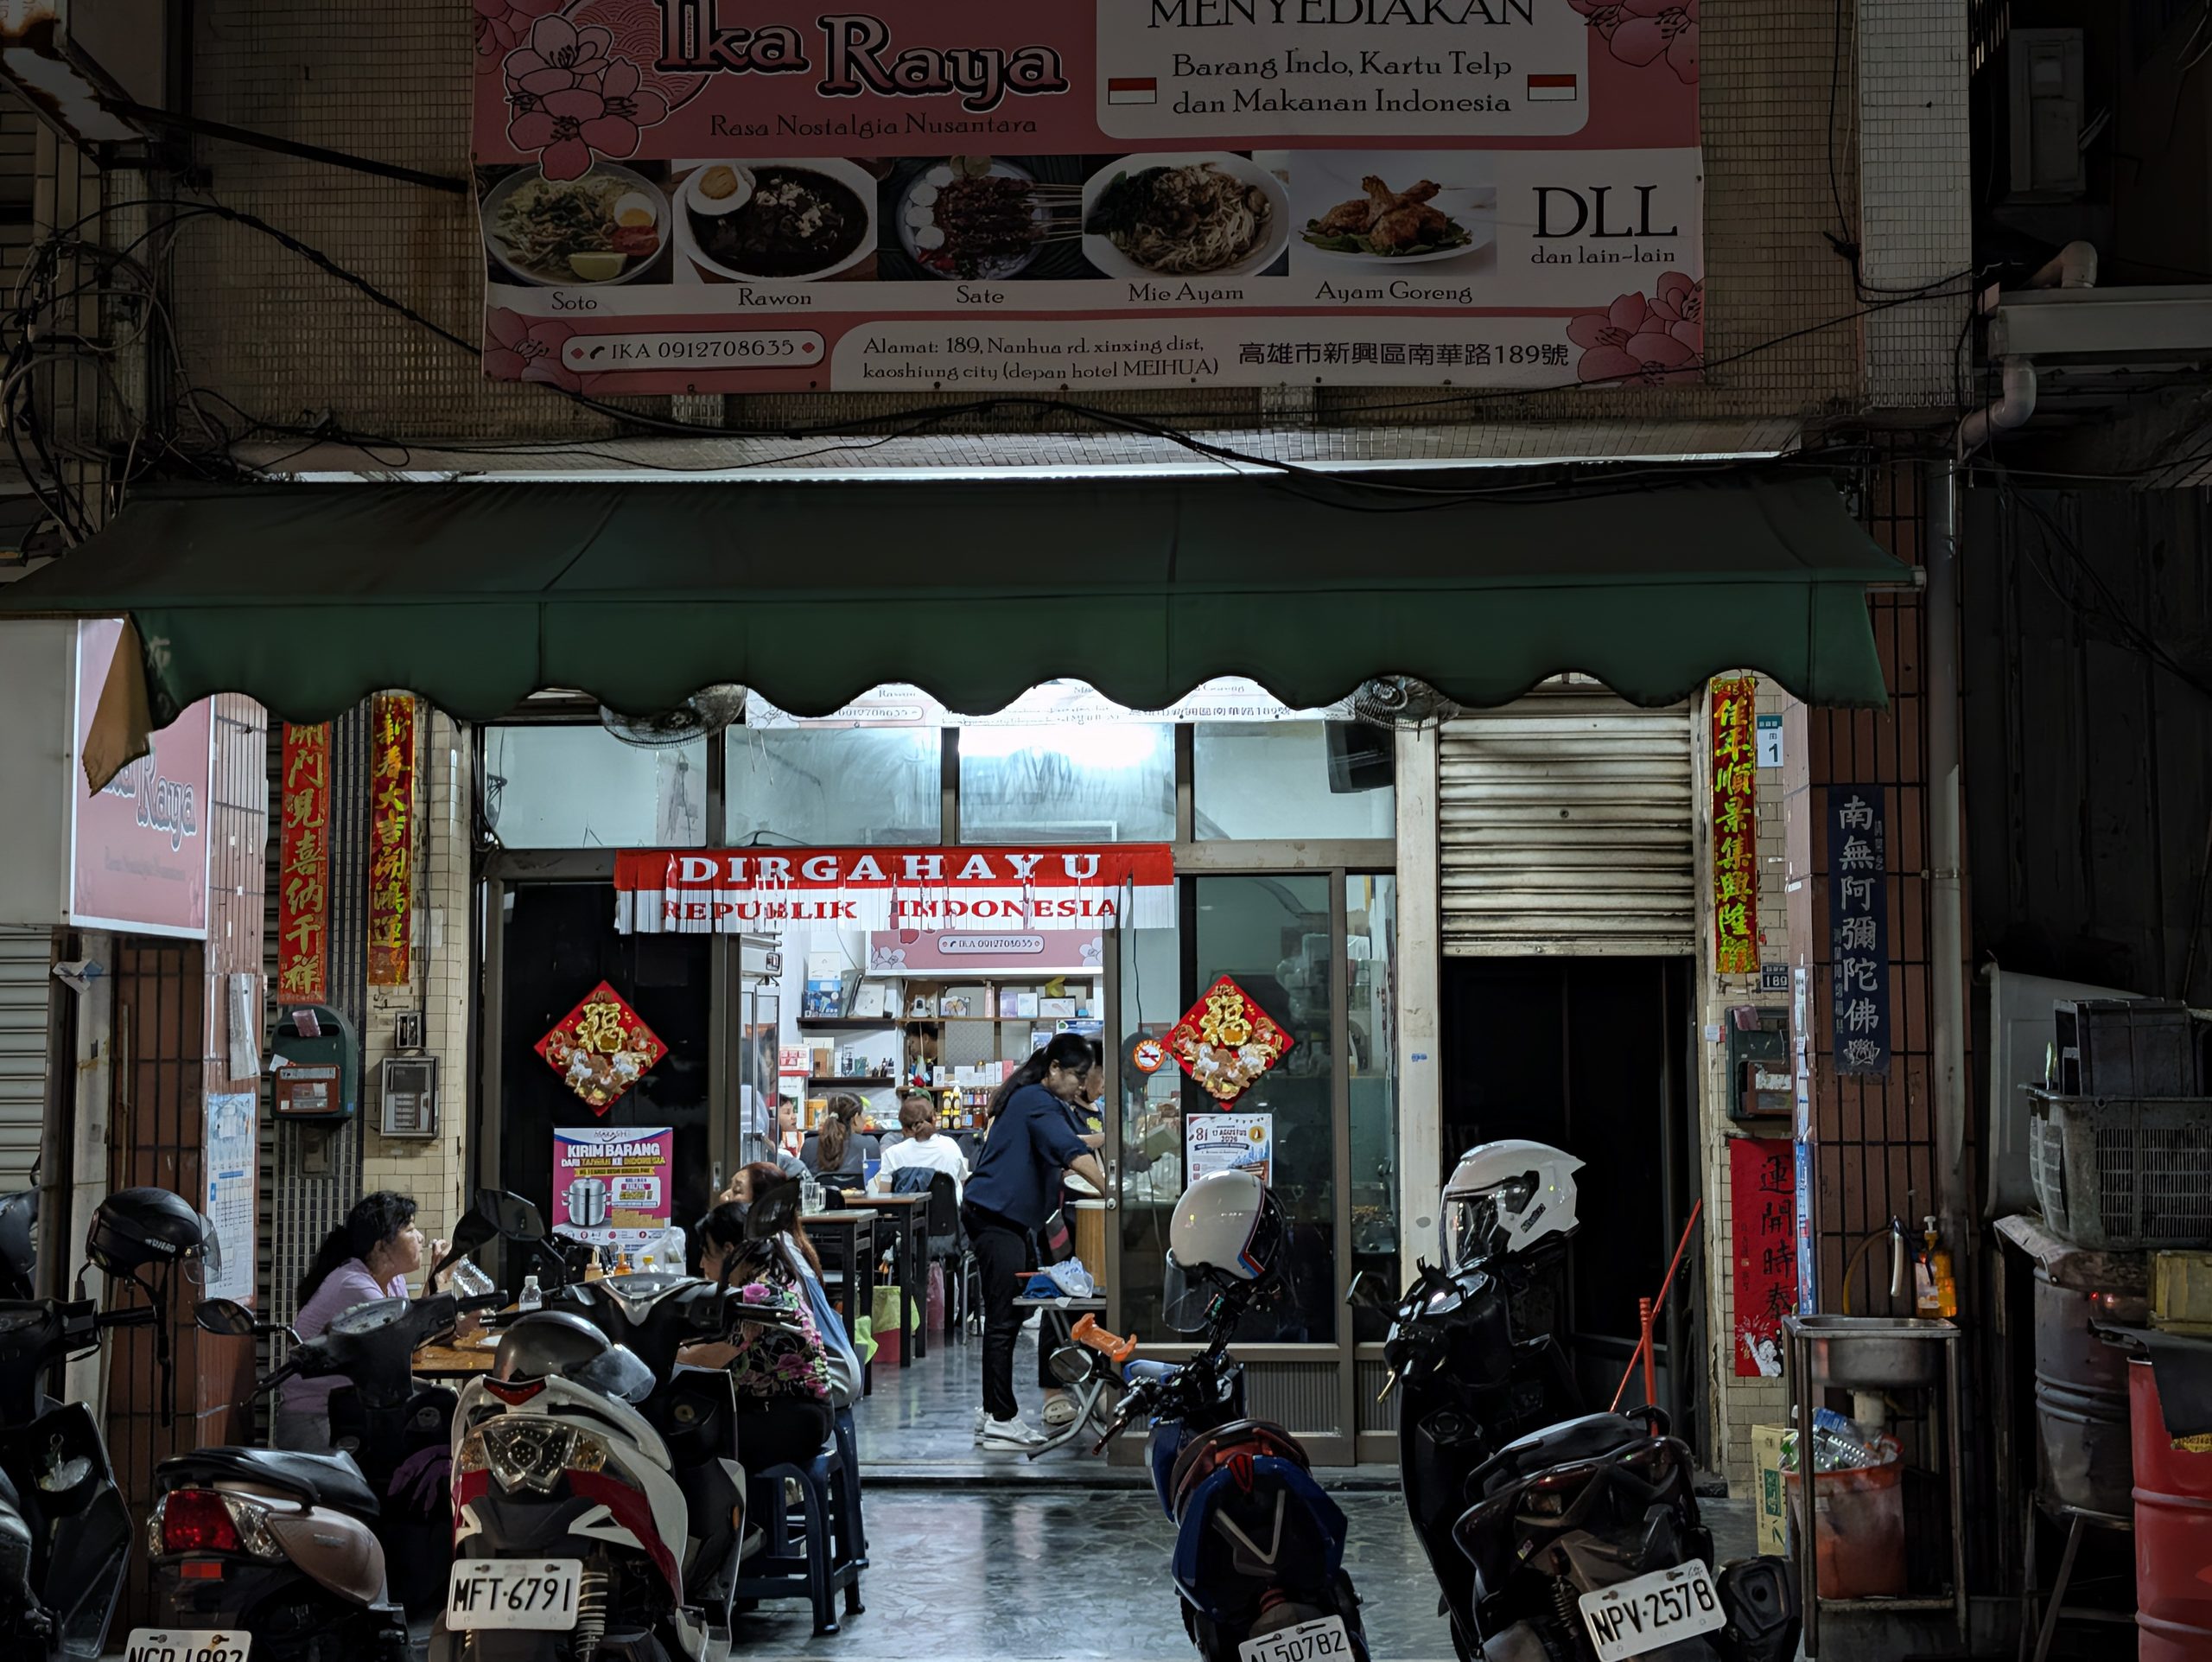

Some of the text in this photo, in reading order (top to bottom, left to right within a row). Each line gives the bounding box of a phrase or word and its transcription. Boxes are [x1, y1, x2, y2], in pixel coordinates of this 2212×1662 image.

[1147, 0, 1534, 28] MENYEDIAKAN
[654, 0, 810, 74] Ika
[816, 13, 1071, 113] Raya
[1172, 49, 1512, 80] Barang Indo, Kartu Telp
[1173, 89, 1511, 114] dan Makanan Indonesia
[710, 112, 1037, 139] Rasa Nostalgia Nusantara
[1532, 185, 1678, 238] DLL
[1531, 245, 1675, 264] dan lain-lain
[551, 291, 597, 309] Soto
[738, 287, 811, 306] Rawon
[957, 284, 1004, 304] Sate
[1128, 282, 1243, 304] Mie Ayam
[1315, 281, 1472, 304] Ayam Goreng
[612, 340, 794, 359] IKA 0912708635
[864, 337, 938, 353] Alamat:
[946, 337, 983, 355] 189,
[988, 337, 1061, 353] Nanhua
[1094, 336, 1162, 354] xinxing
[1239, 342, 1569, 367] 高雄市新興區南華路189號
[864, 359, 1219, 381] kaoshiung city (depan hotel MEIHUA)
[137, 754, 197, 852] Raya
[660, 898, 1117, 921] REPUBLIK INDONESIA
[1839, 794, 1879, 1035] 南無阿彌陀佛
[568, 1143, 660, 1157] KIRIM BARANG
